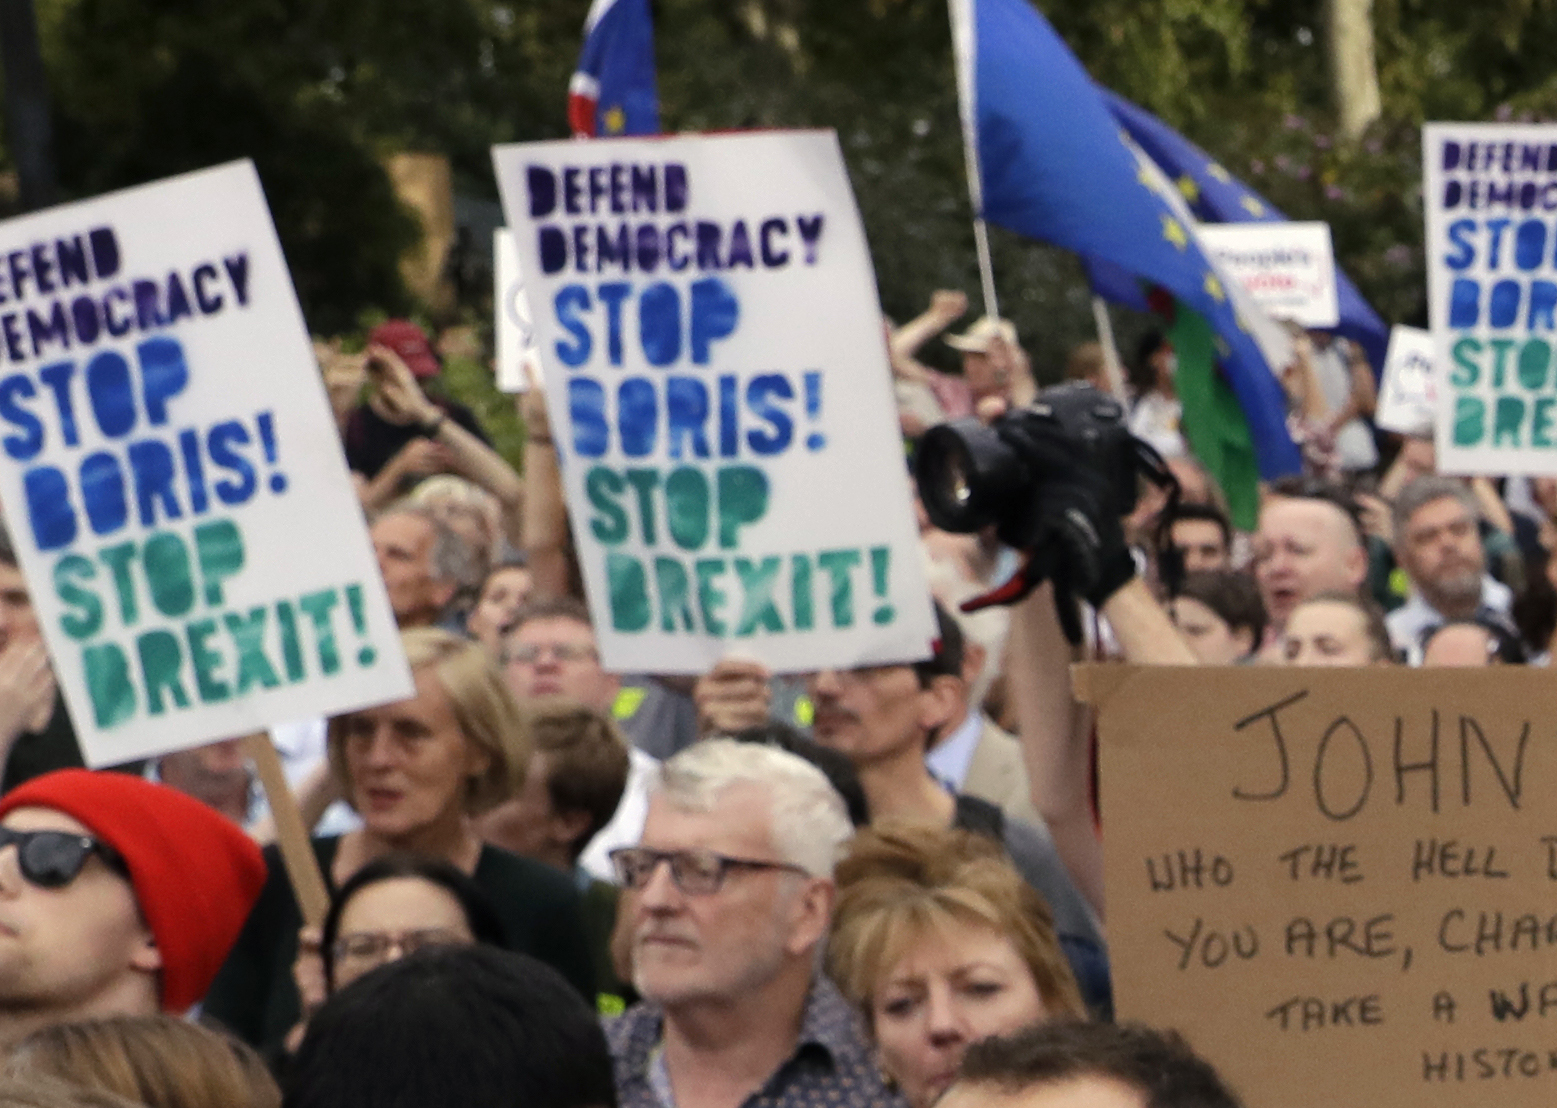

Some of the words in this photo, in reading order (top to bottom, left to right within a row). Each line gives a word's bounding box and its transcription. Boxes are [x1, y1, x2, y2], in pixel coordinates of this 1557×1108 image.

[527, 162, 689, 219] DEFEND
[0, 227, 120, 304] FEND
[538, 213, 824, 275] DEMOCRACY
[0, 251, 250, 362] EMOCRACY
[553, 276, 740, 368] STOP
[0, 335, 189, 461] STOP
[567, 371, 827, 459] BORIS!
[23, 409, 288, 552] BORIS!
[584, 463, 770, 550] STOP
[52, 517, 246, 641] STOP
[606, 545, 897, 637] BREXIT!
[81, 582, 377, 731] BREXIT!
[1145, 847, 1235, 893] WHO
[1278, 844, 1365, 884] THE
[1411, 838, 1512, 882] HELL
[1164, 916, 1260, 971] YOU
[1284, 913, 1414, 971] ARE,
[1264, 994, 1385, 1032] TAKE
[1432, 990, 1457, 1024] A
